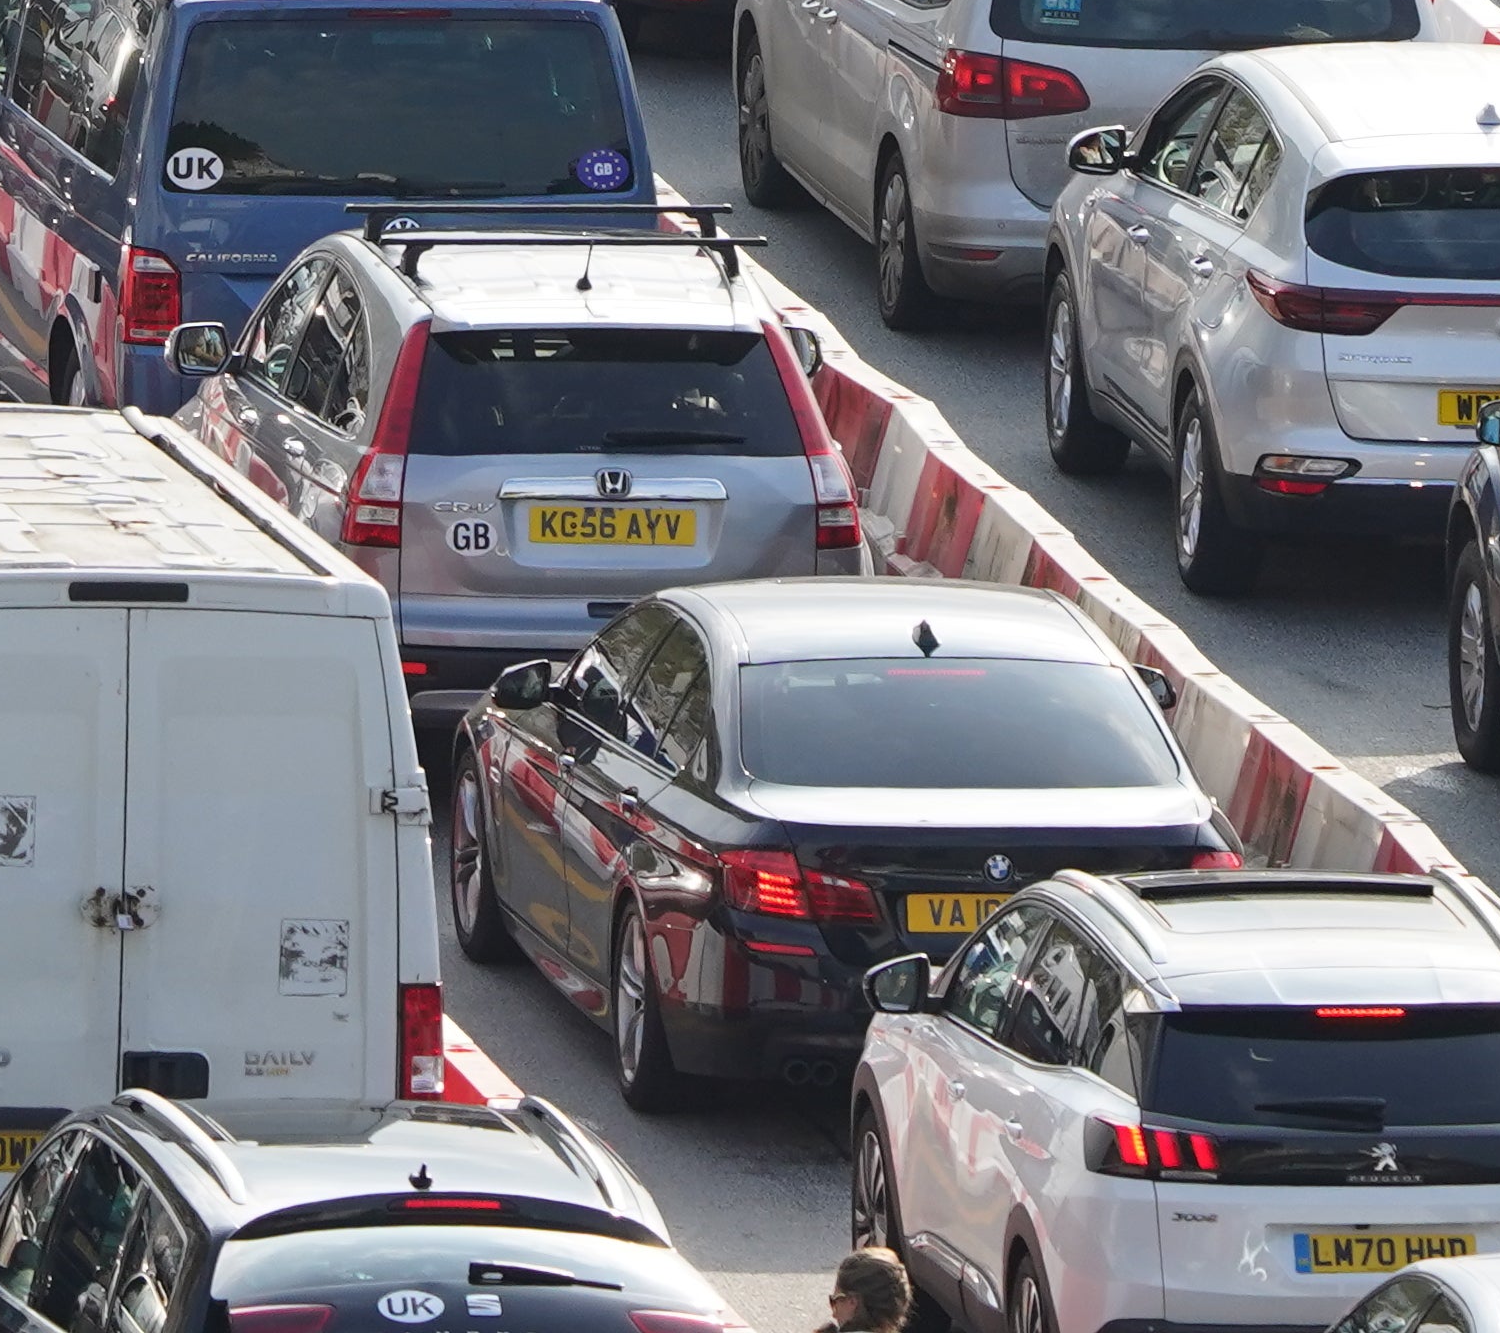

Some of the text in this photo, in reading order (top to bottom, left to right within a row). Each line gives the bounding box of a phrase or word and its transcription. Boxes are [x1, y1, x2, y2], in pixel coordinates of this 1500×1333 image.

[173, 156, 217, 180] UK
[594, 162, 614, 176] GB
[186, 253, 279, 264] CALIFORNIA
[432, 501, 497, 515] CR-V
[626, 513, 680, 541] AYV
[452, 523, 491, 550] GB
[245, 1050, 316, 1067] DAILY
[1348, 1174, 1423, 1183] PEUGEOT
[1311, 1237, 1395, 1268] LM70
[386, 1297, 435, 1317] UK
